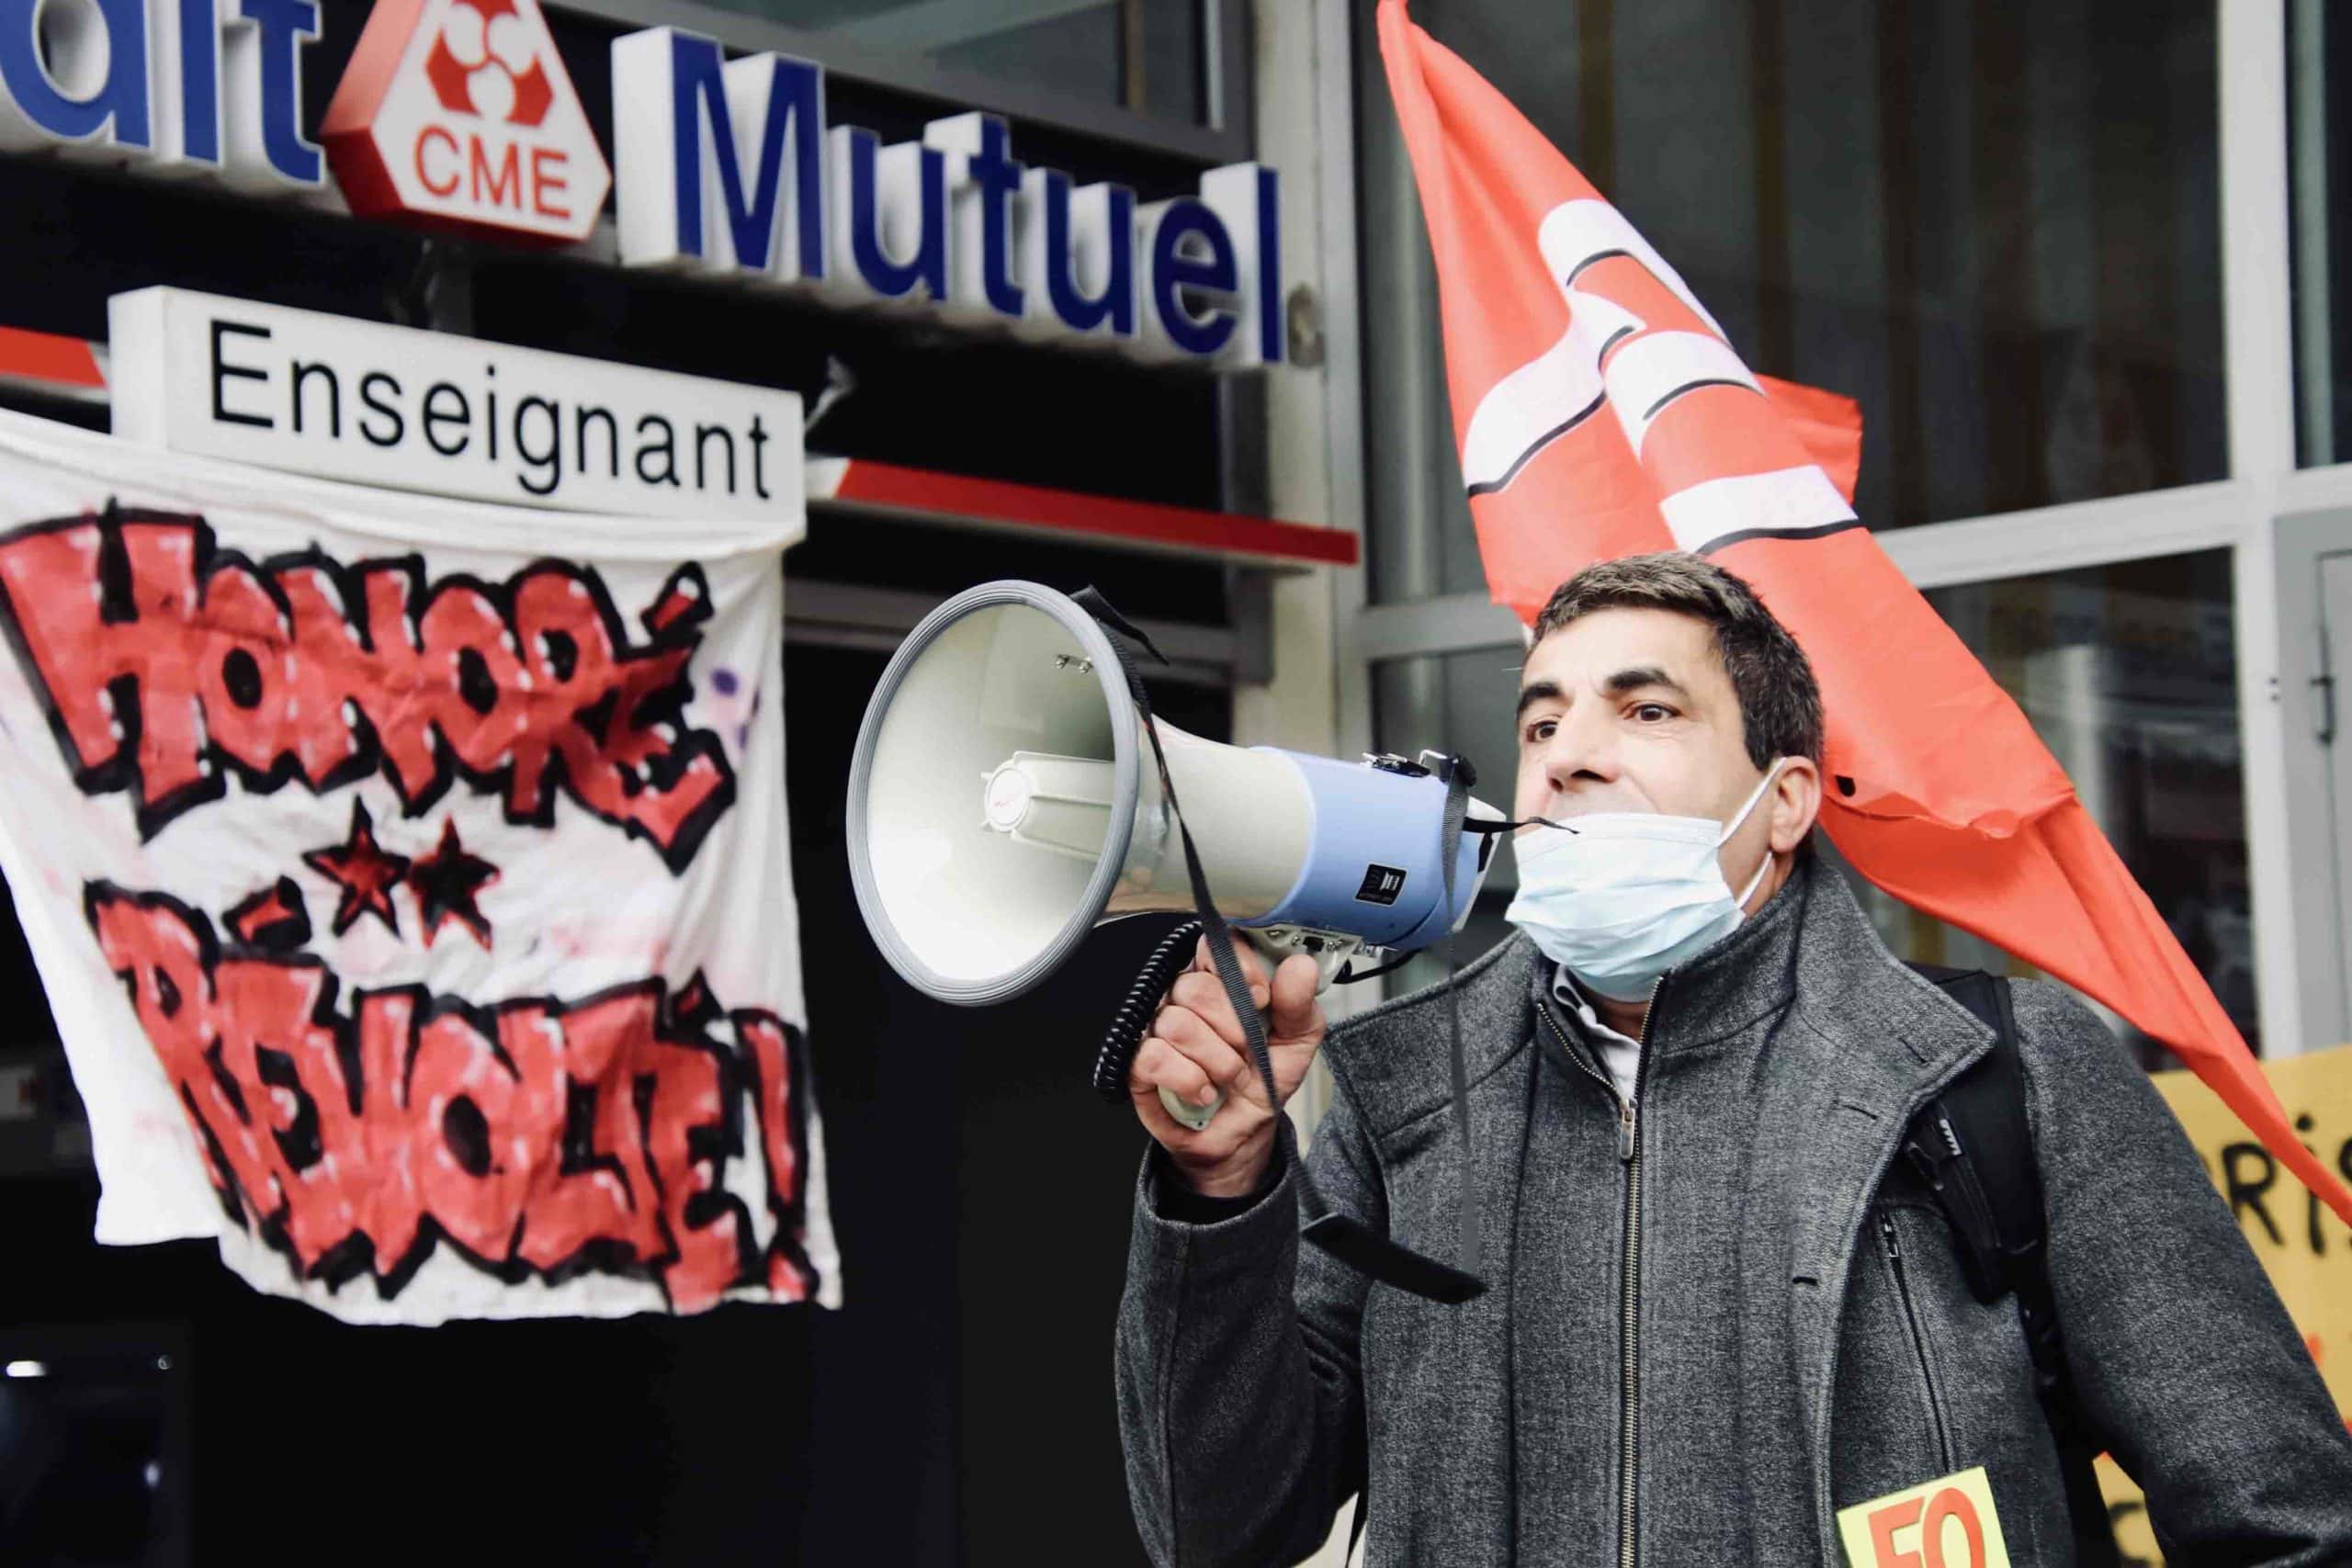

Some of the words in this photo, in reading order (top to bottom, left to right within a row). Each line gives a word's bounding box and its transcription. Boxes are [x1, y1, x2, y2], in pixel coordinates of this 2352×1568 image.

[413, 125, 573, 220] CME
[671, 31, 1283, 363] Mutuel
[209, 319, 772, 497] Enseignant
